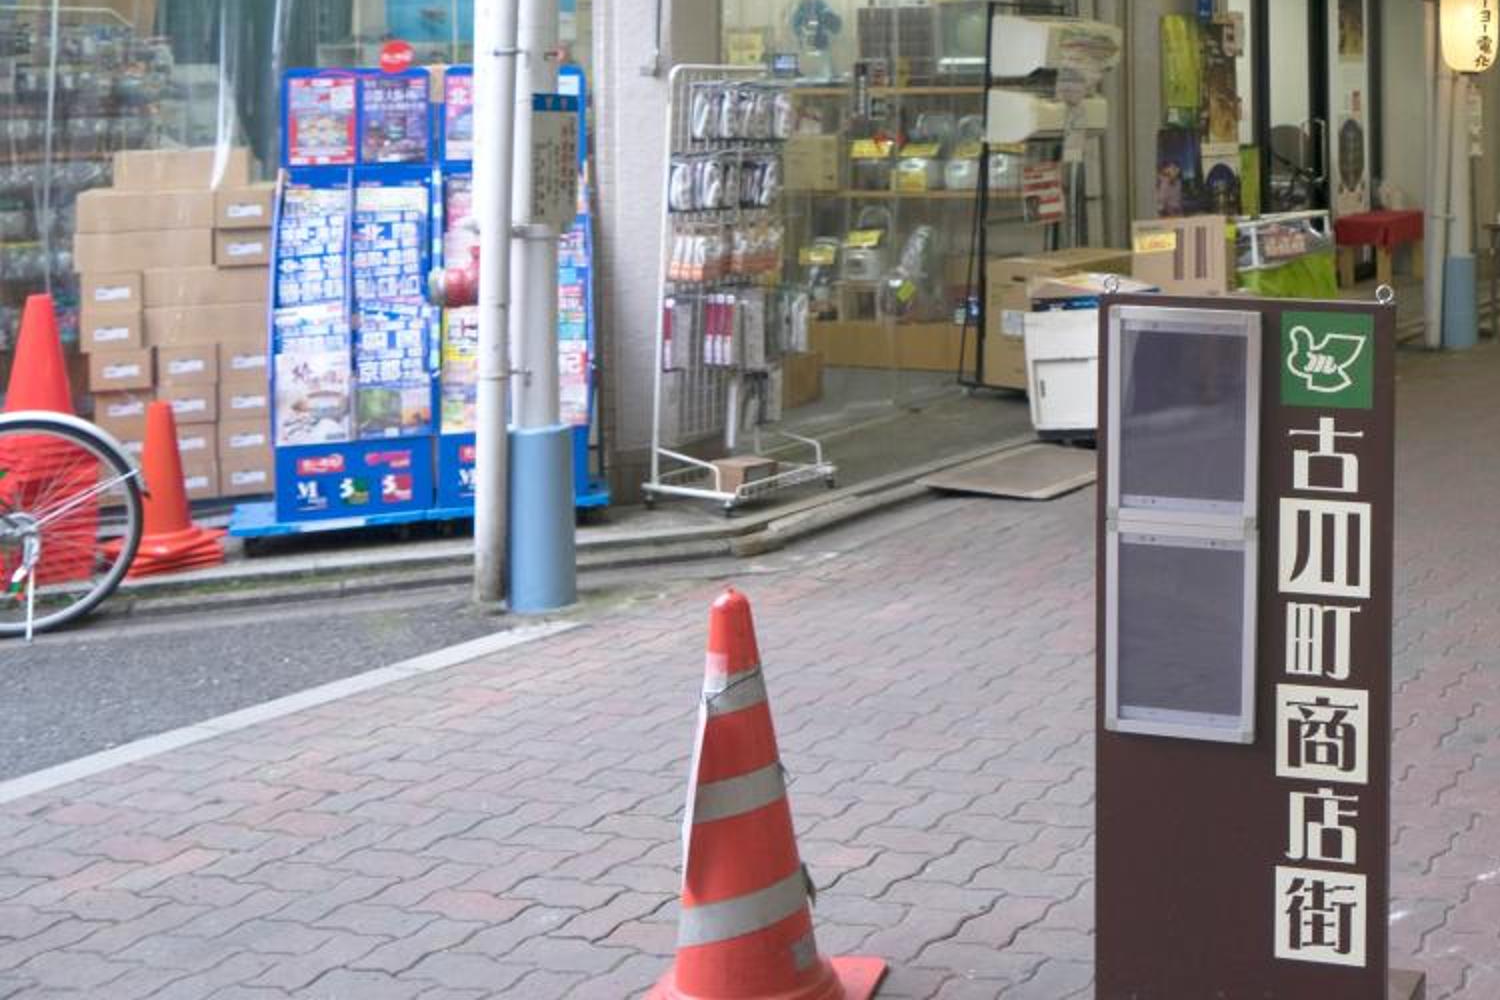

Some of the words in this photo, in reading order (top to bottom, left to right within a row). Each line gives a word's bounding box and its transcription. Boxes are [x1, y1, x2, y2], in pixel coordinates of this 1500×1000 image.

[1280, 416, 1369, 966] 古川町商店街
